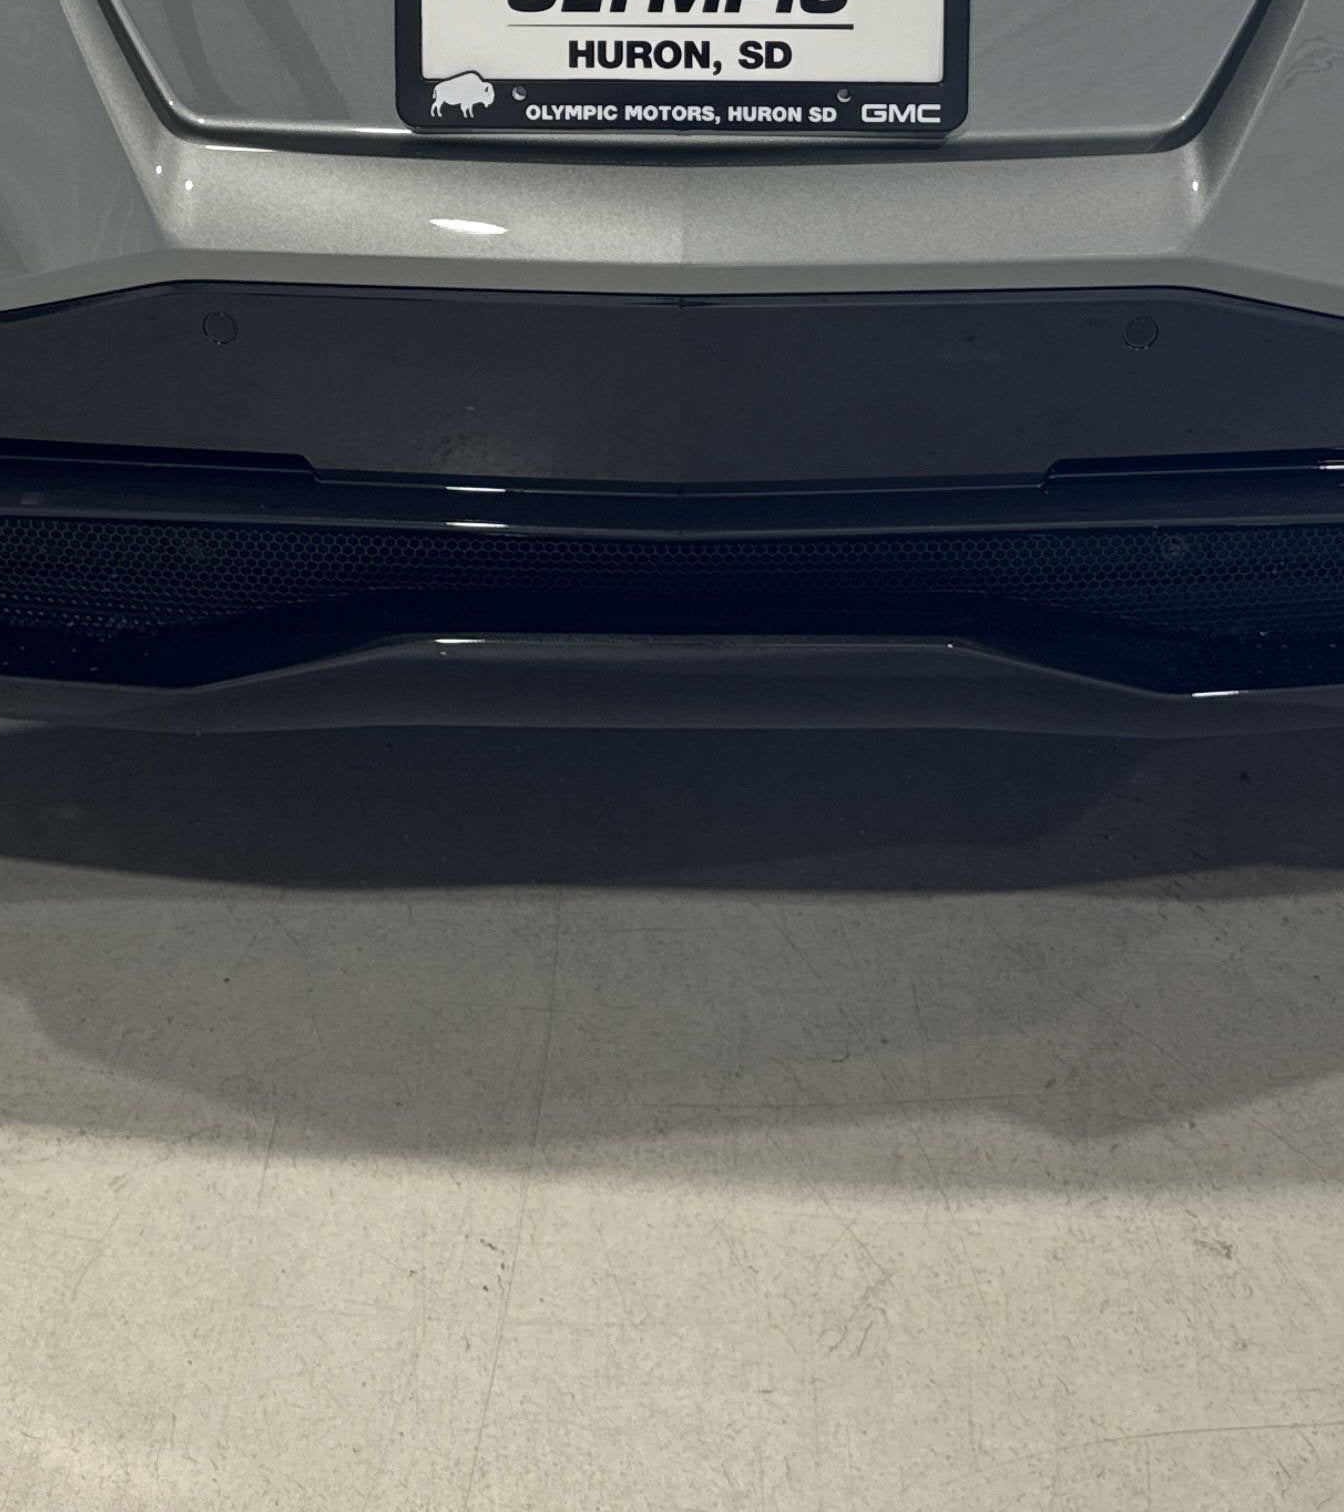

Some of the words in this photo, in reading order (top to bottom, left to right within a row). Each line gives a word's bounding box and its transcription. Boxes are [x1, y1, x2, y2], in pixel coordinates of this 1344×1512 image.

[567, 40, 722, 75] HURON,
[738, 40, 793, 70] SD
[525, 105, 618, 122] OLYMPIC
[625, 104, 721, 124] MOTORS,
[728, 105, 803, 123] HURON
[809, 106, 838, 123] SD
[861, 104, 942, 124] GMC
